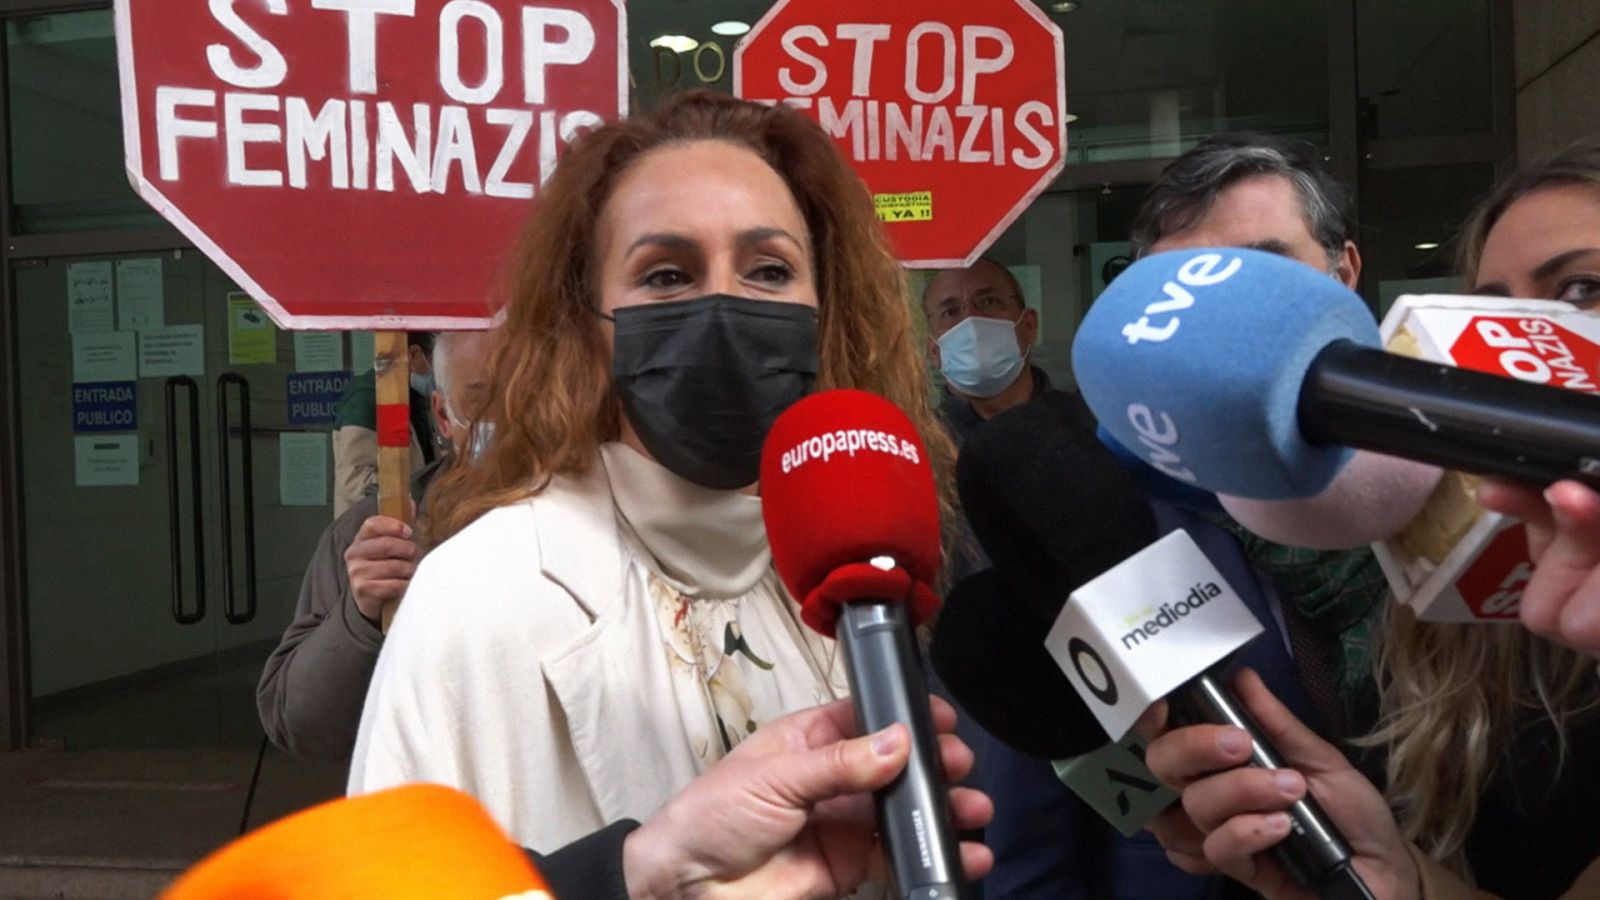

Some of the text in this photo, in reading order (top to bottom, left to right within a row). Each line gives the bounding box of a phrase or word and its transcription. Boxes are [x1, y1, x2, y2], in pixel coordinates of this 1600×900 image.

[205, 0, 596, 104] STOP
[777, 20, 1015, 106] STOP
[752, 96, 1055, 170] MINAZIS
[893, 209, 915, 219] YA
[1122, 251, 1243, 346] tve
[1475, 319, 1552, 384] OP
[75, 386, 134, 404] ENTRADA
[77, 409, 133, 426] PUBLICO
[292, 401, 338, 418] PUBLIC
[781, 428, 920, 475] europapress.es
[1120, 580, 1223, 651] mediodía
